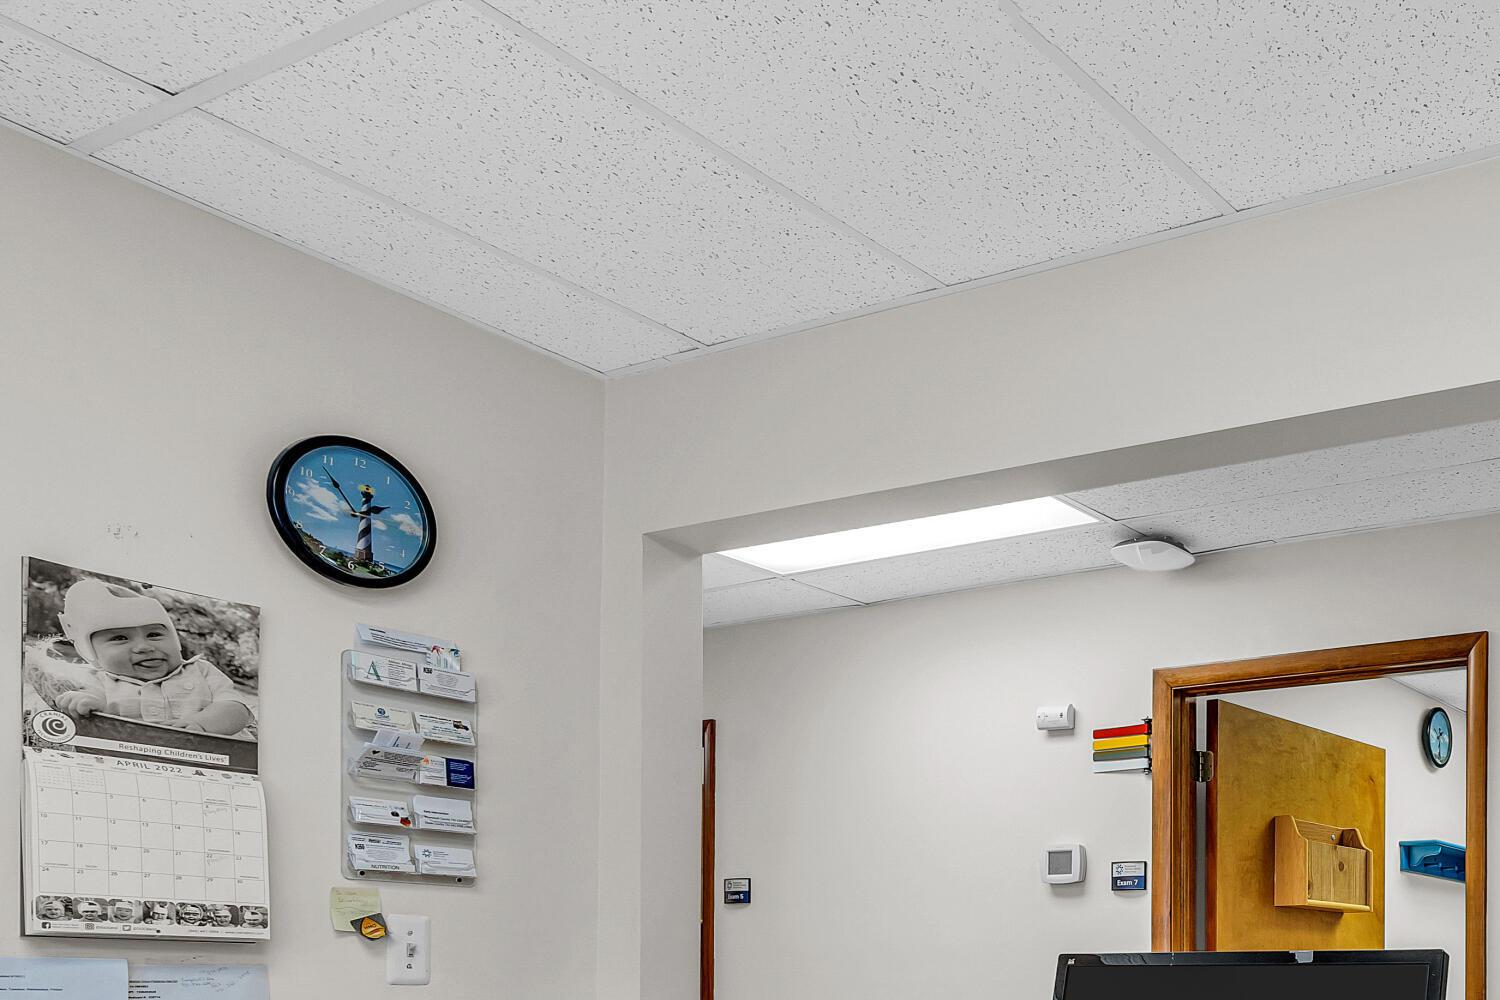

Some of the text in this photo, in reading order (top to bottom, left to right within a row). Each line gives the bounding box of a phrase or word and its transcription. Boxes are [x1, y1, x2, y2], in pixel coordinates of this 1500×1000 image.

[322, 455, 334, 466] 11
[354, 458, 367, 469] 12
[300, 466, 313, 478] 10
[404, 501, 411, 509] 2
[347, 560, 355, 569] 6
[118, 743, 162, 755] Reshaping
[164, 749, 203, 760] Children's
[115, 759, 183, 774] APRIL 2022
